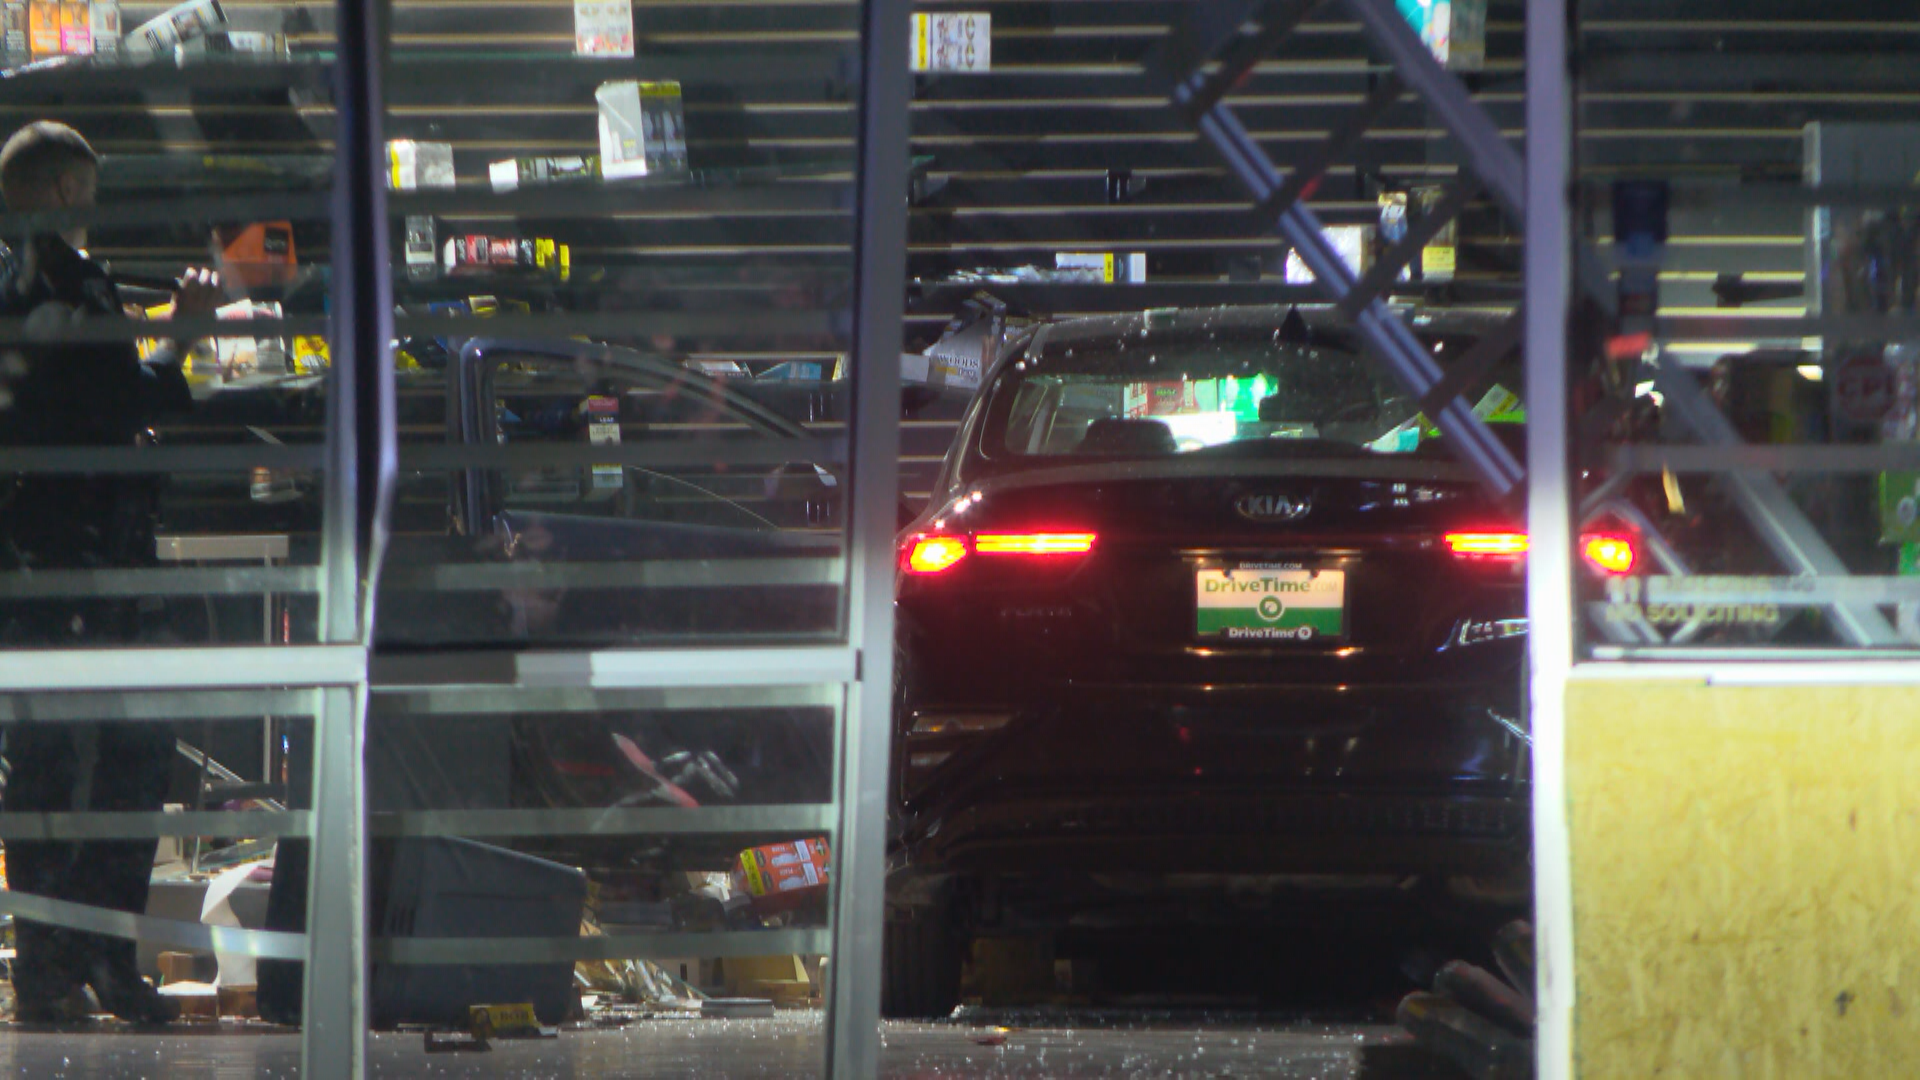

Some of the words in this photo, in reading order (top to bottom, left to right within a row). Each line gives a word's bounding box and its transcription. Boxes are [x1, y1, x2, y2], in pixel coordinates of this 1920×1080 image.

[1247, 494, 1293, 515] KIA
[1239, 562, 1302, 570] DRIVETIME.COM
[1204, 577, 1311, 593] DriveTime
[1228, 626, 1296, 639] DriveTime
